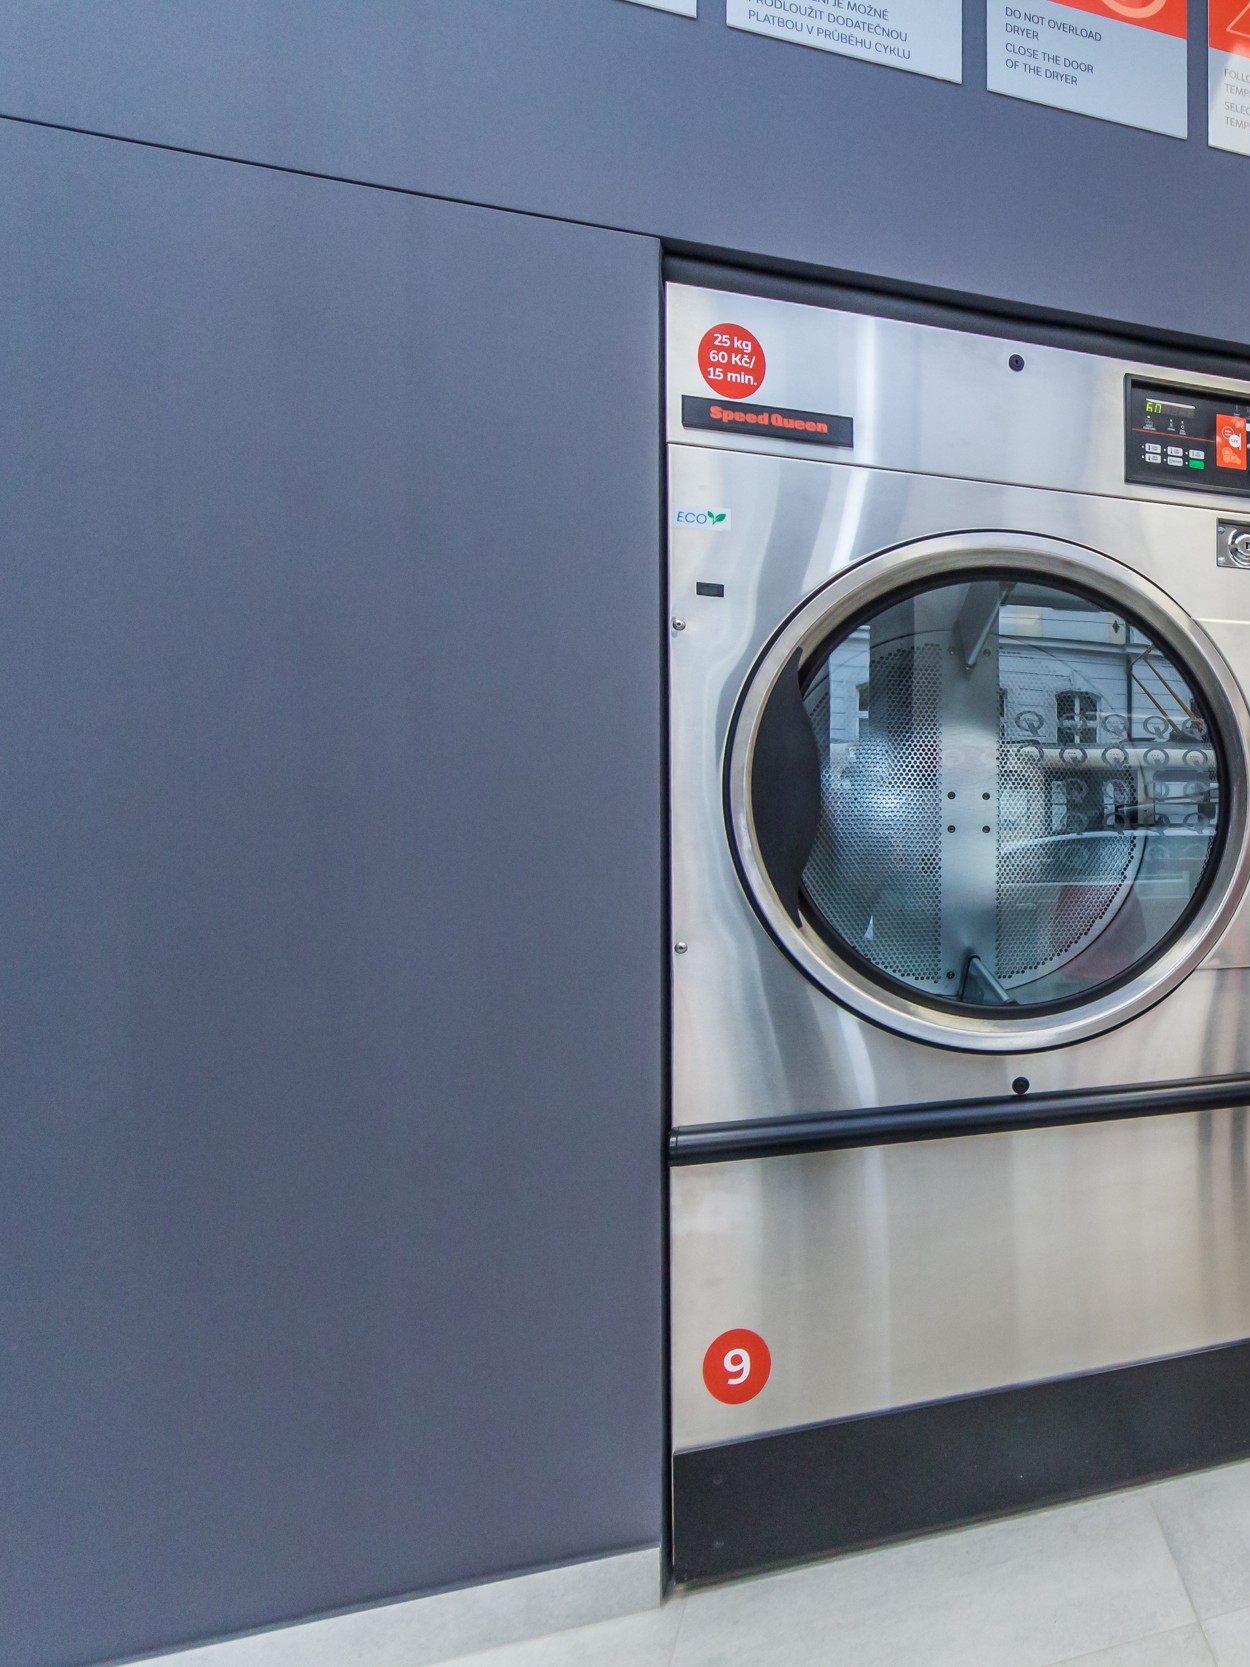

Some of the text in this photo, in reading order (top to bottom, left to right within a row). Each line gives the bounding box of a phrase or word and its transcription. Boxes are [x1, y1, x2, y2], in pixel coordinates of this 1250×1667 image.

[749, 0, 907, 42] ODLOUŽIT DODATEČNOU
[847, 3, 889, 21] MOŽNÉ
[749, 10, 910, 59] PLATBOU V PRŮBĚHU CYKLU
[1005, 7, 1101, 41] DO NOT OVERLOAD
[1005, 23, 1039, 40] DRYER
[1005, 42, 1094, 73] CLOSE THE DOOR
[1005, 59, 1078, 85] OF THE DRYER
[713, 334, 751, 352] 25 kg
[709, 350, 756, 368] 60 Kč/
[708, 367, 757, 386] 15 min.
[676, 511, 707, 524] ECO
[723, 1348, 751, 1385] 9
